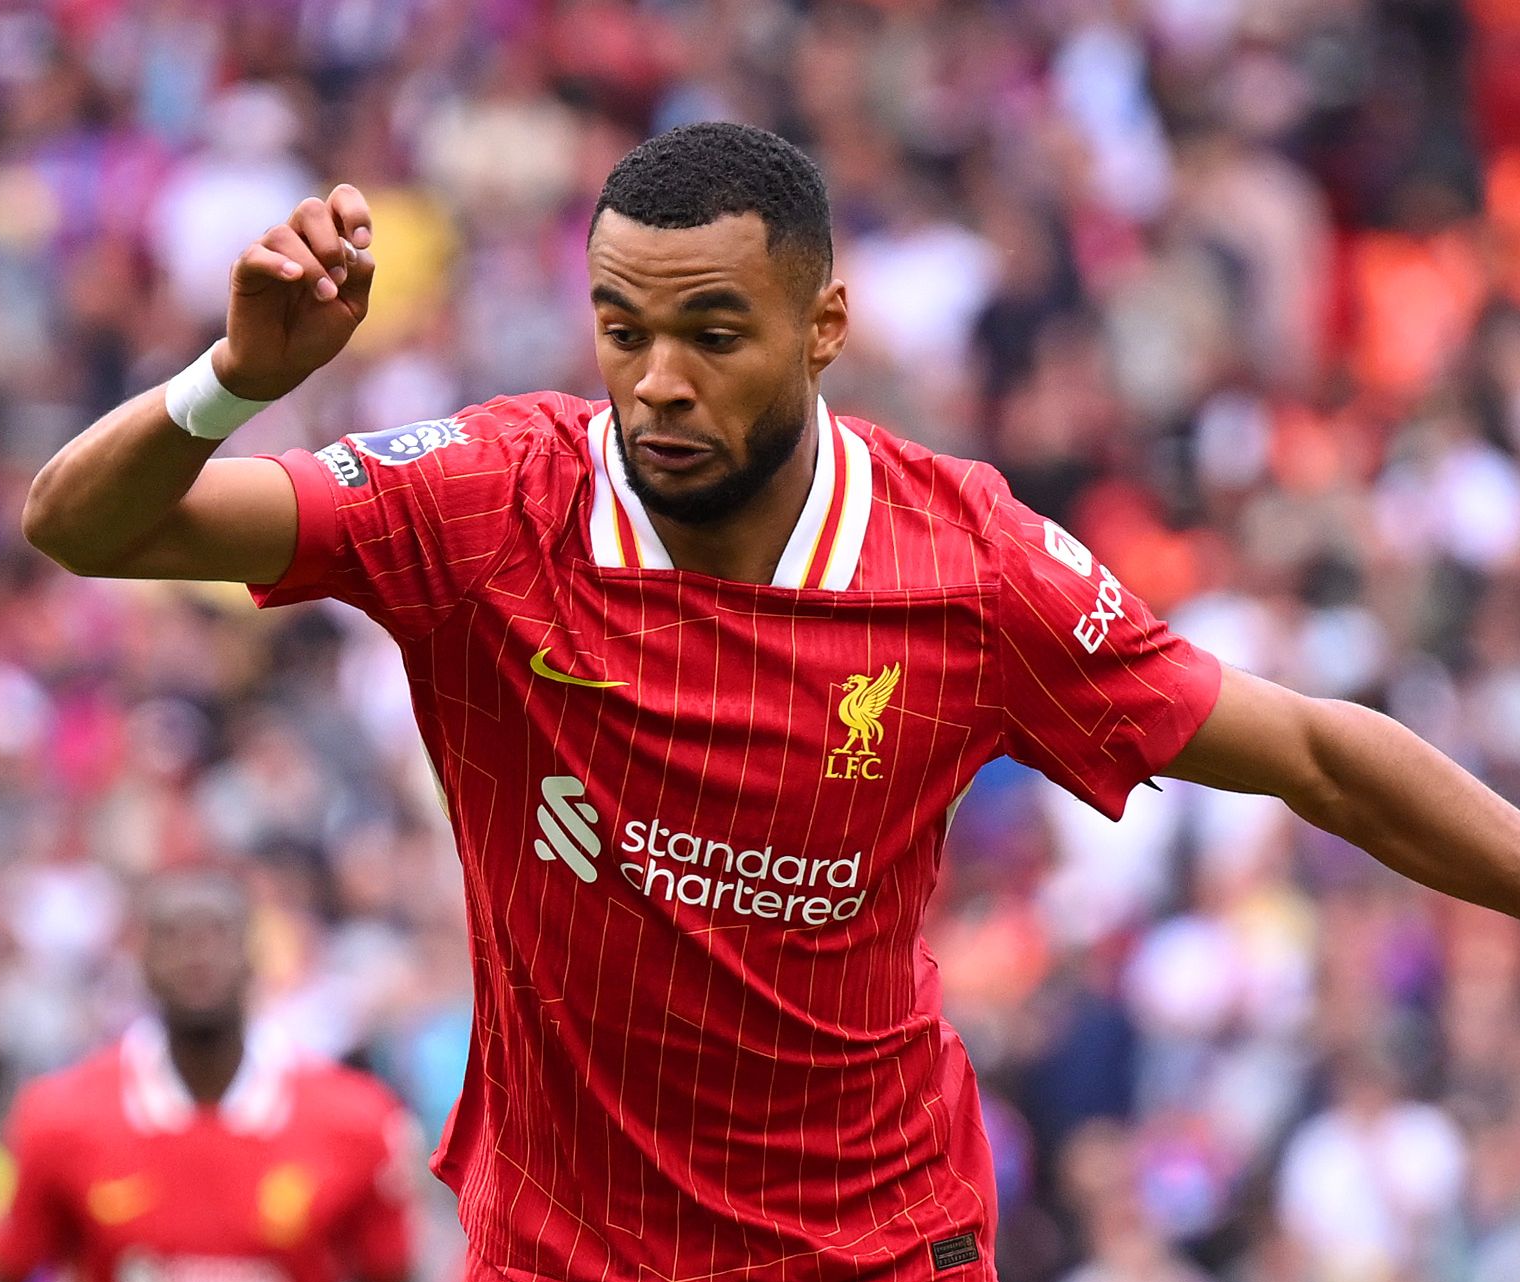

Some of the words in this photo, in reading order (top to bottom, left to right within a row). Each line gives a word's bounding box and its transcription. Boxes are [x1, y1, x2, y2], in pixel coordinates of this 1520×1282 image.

[824, 755, 884, 780] L.F.C.
[620, 818, 862, 888] standard
[619, 857, 867, 926] chartered
